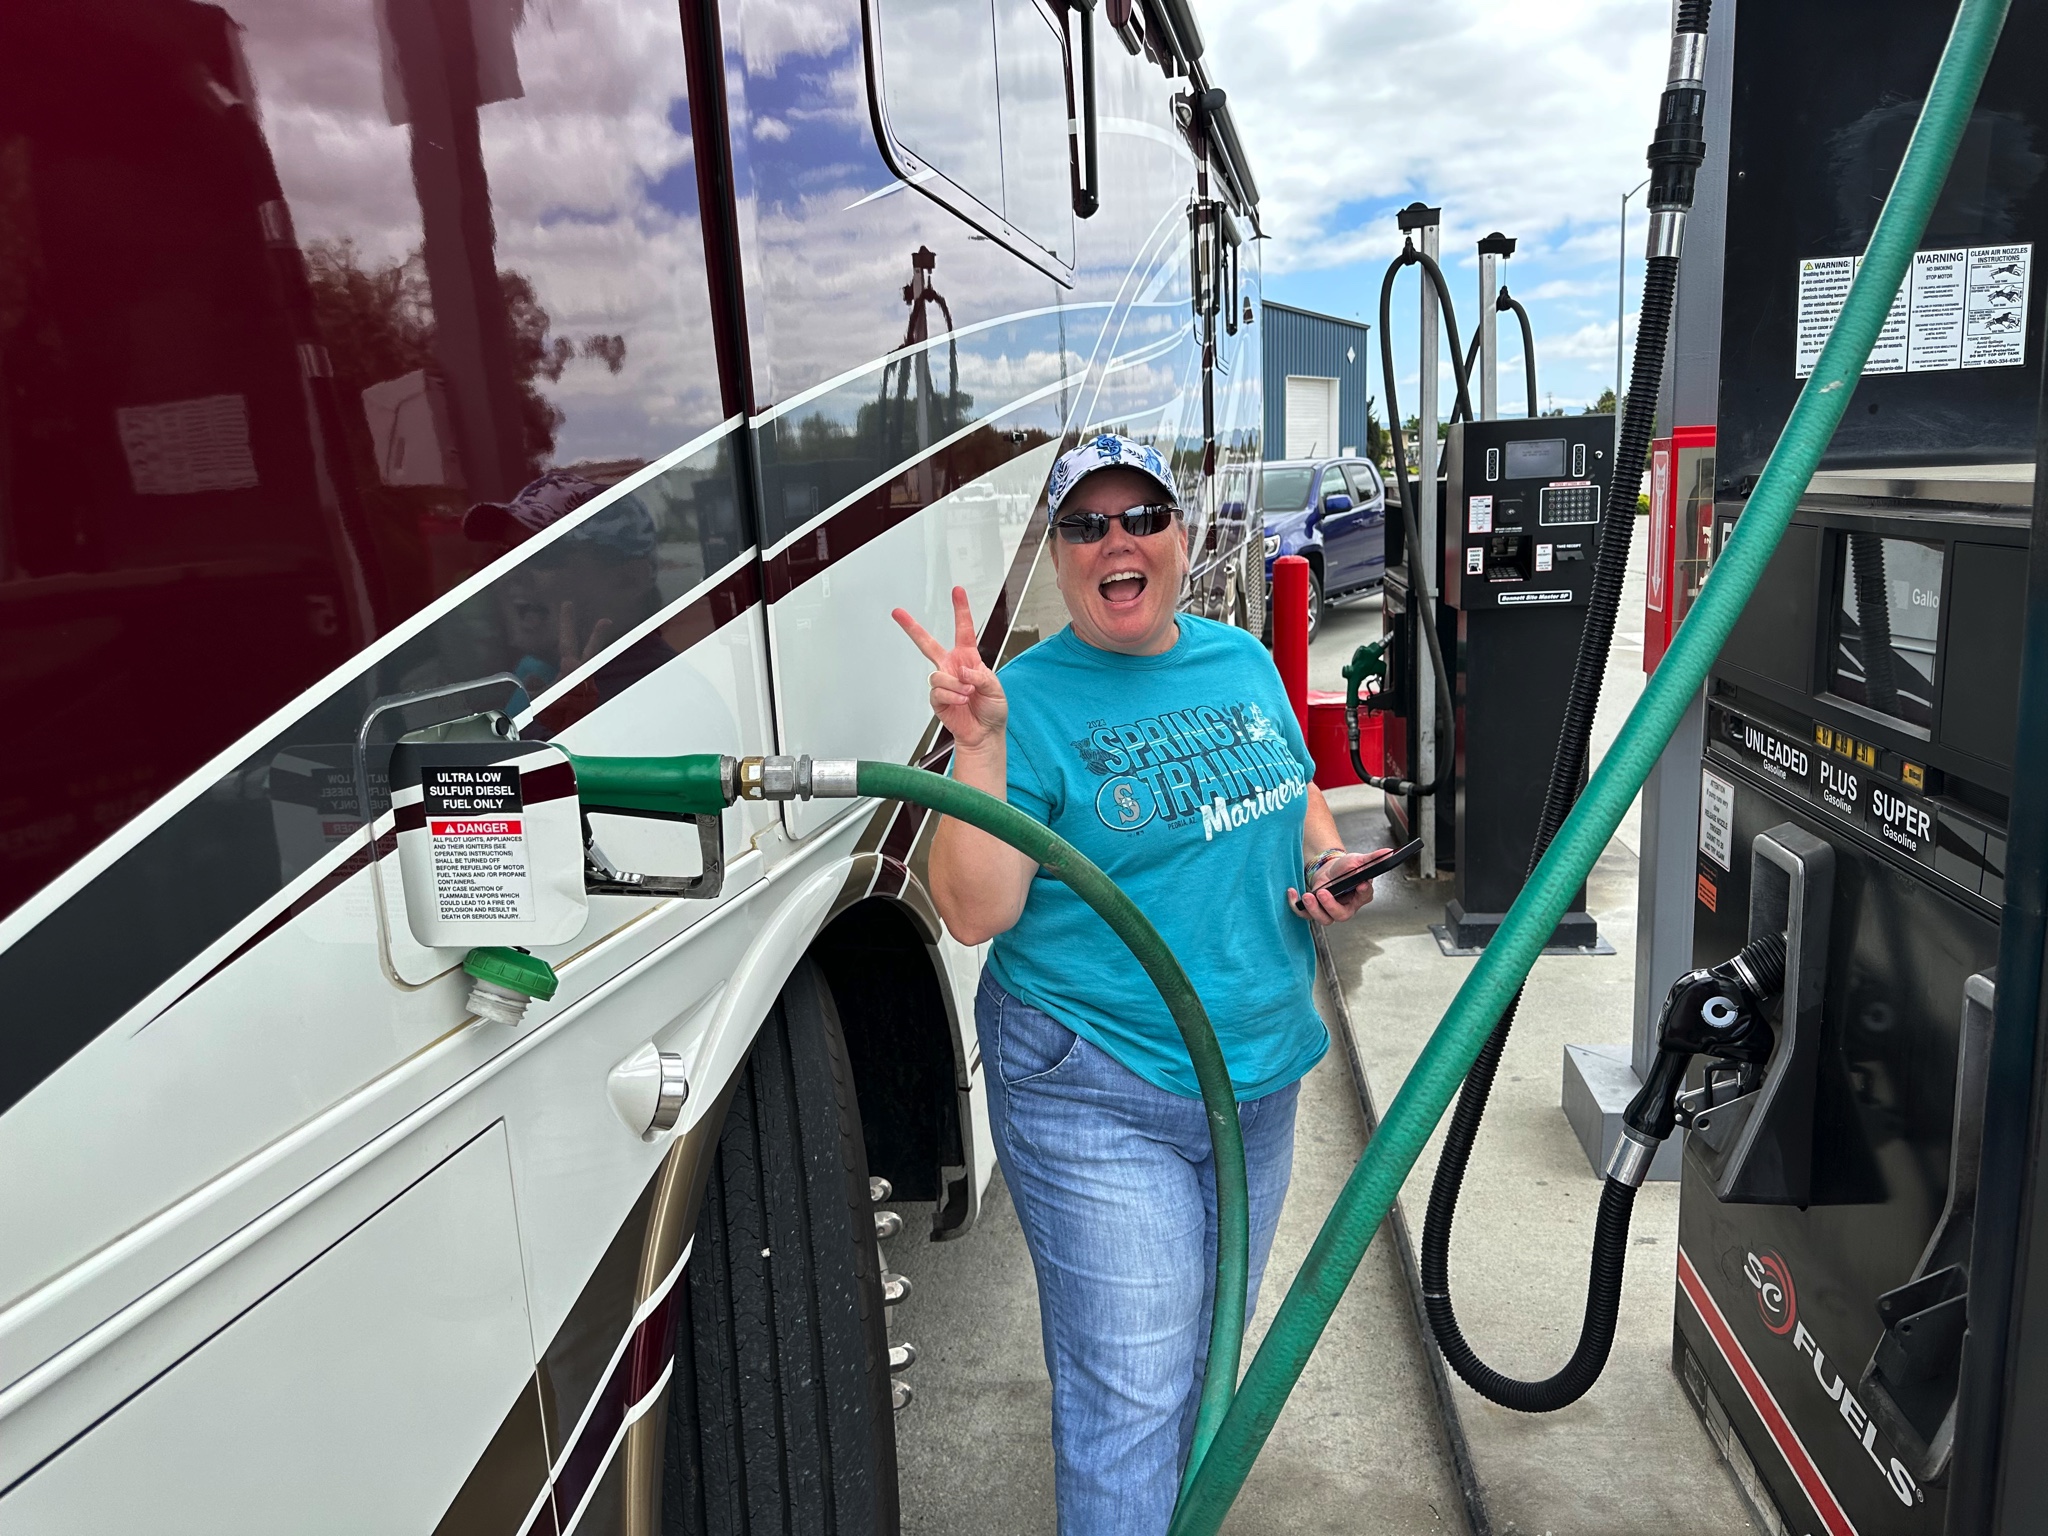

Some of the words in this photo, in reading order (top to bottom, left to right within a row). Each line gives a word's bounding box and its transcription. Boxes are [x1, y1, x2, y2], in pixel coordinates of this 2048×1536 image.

[1815, 261, 1850, 269] WARNING:
[1917, 253, 1963, 264] WARNING
[1092, 706, 1236, 775] SPRING
[1745, 726, 1808, 777] UNLEADED
[437, 773, 474, 783] ULTRA
[476, 773, 501, 783] LOW
[1136, 740, 1306, 821] TRAINING
[1763, 759, 1787, 780] Gasoline
[1820, 761, 1858, 801] PLUS
[430, 786, 473, 796] SULFUR
[476, 786, 514, 796] DIESEL
[443, 799, 471, 809] FUEL
[474, 799, 503, 808] ONLY
[1823, 789, 1852, 814] Gasoline
[1200, 775, 1307, 841] Mariners
[1872, 789, 1930, 842] SUPER
[457, 823, 509, 833] DANGER
[1883, 823, 1917, 852] Gasoline
[1793, 1320, 1913, 1507] FUELS
